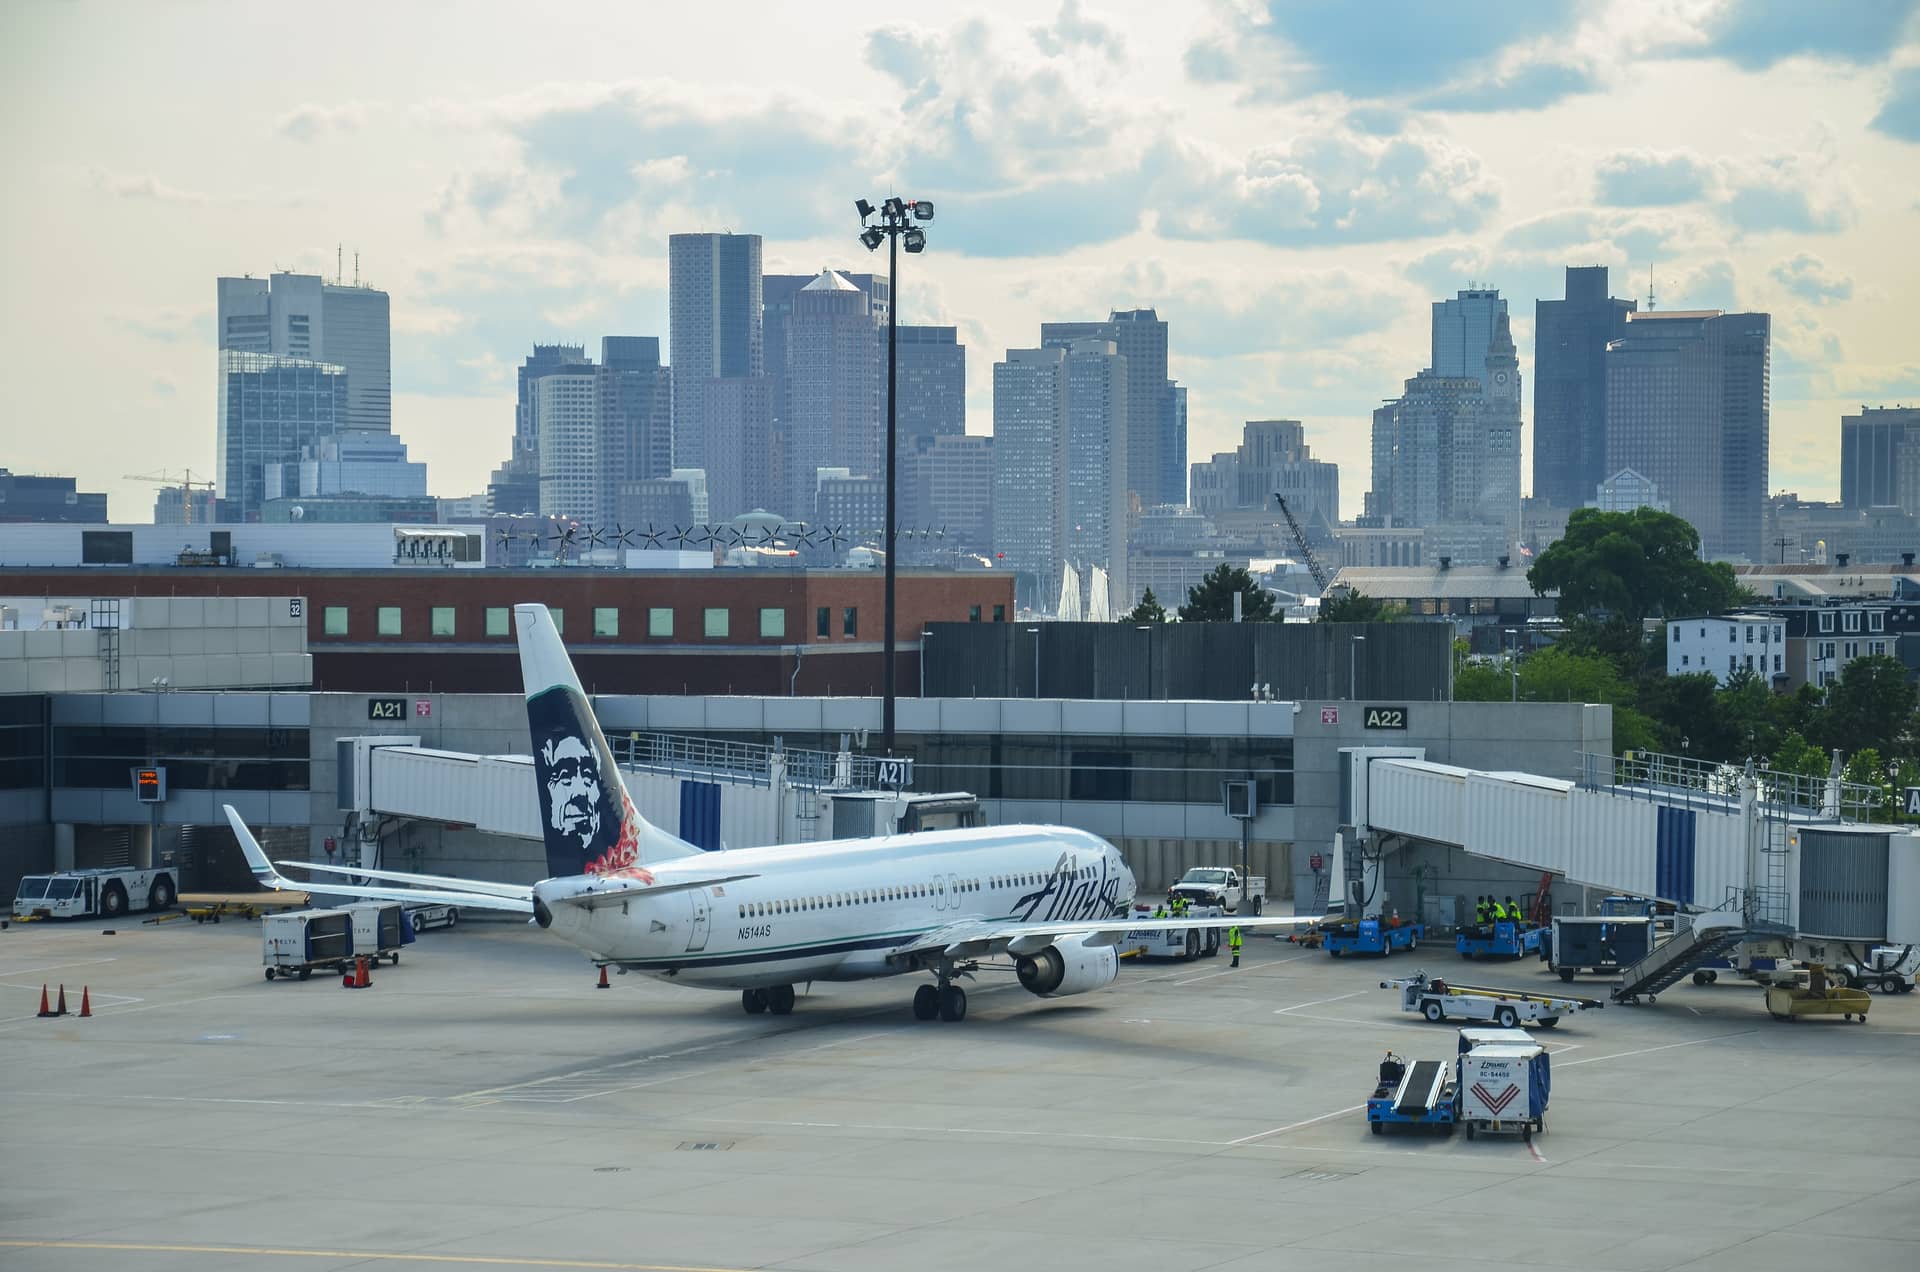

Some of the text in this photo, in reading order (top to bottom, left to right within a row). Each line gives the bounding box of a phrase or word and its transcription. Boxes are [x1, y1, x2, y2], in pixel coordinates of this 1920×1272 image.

[291, 604, 300, 616] 32
[372, 702, 401, 717] A21
[1367, 710, 1402, 727] A22
[878, 762, 905, 784] A21
[1009, 851, 1121, 921] Alaska
[738, 924, 772, 940] N514AS
